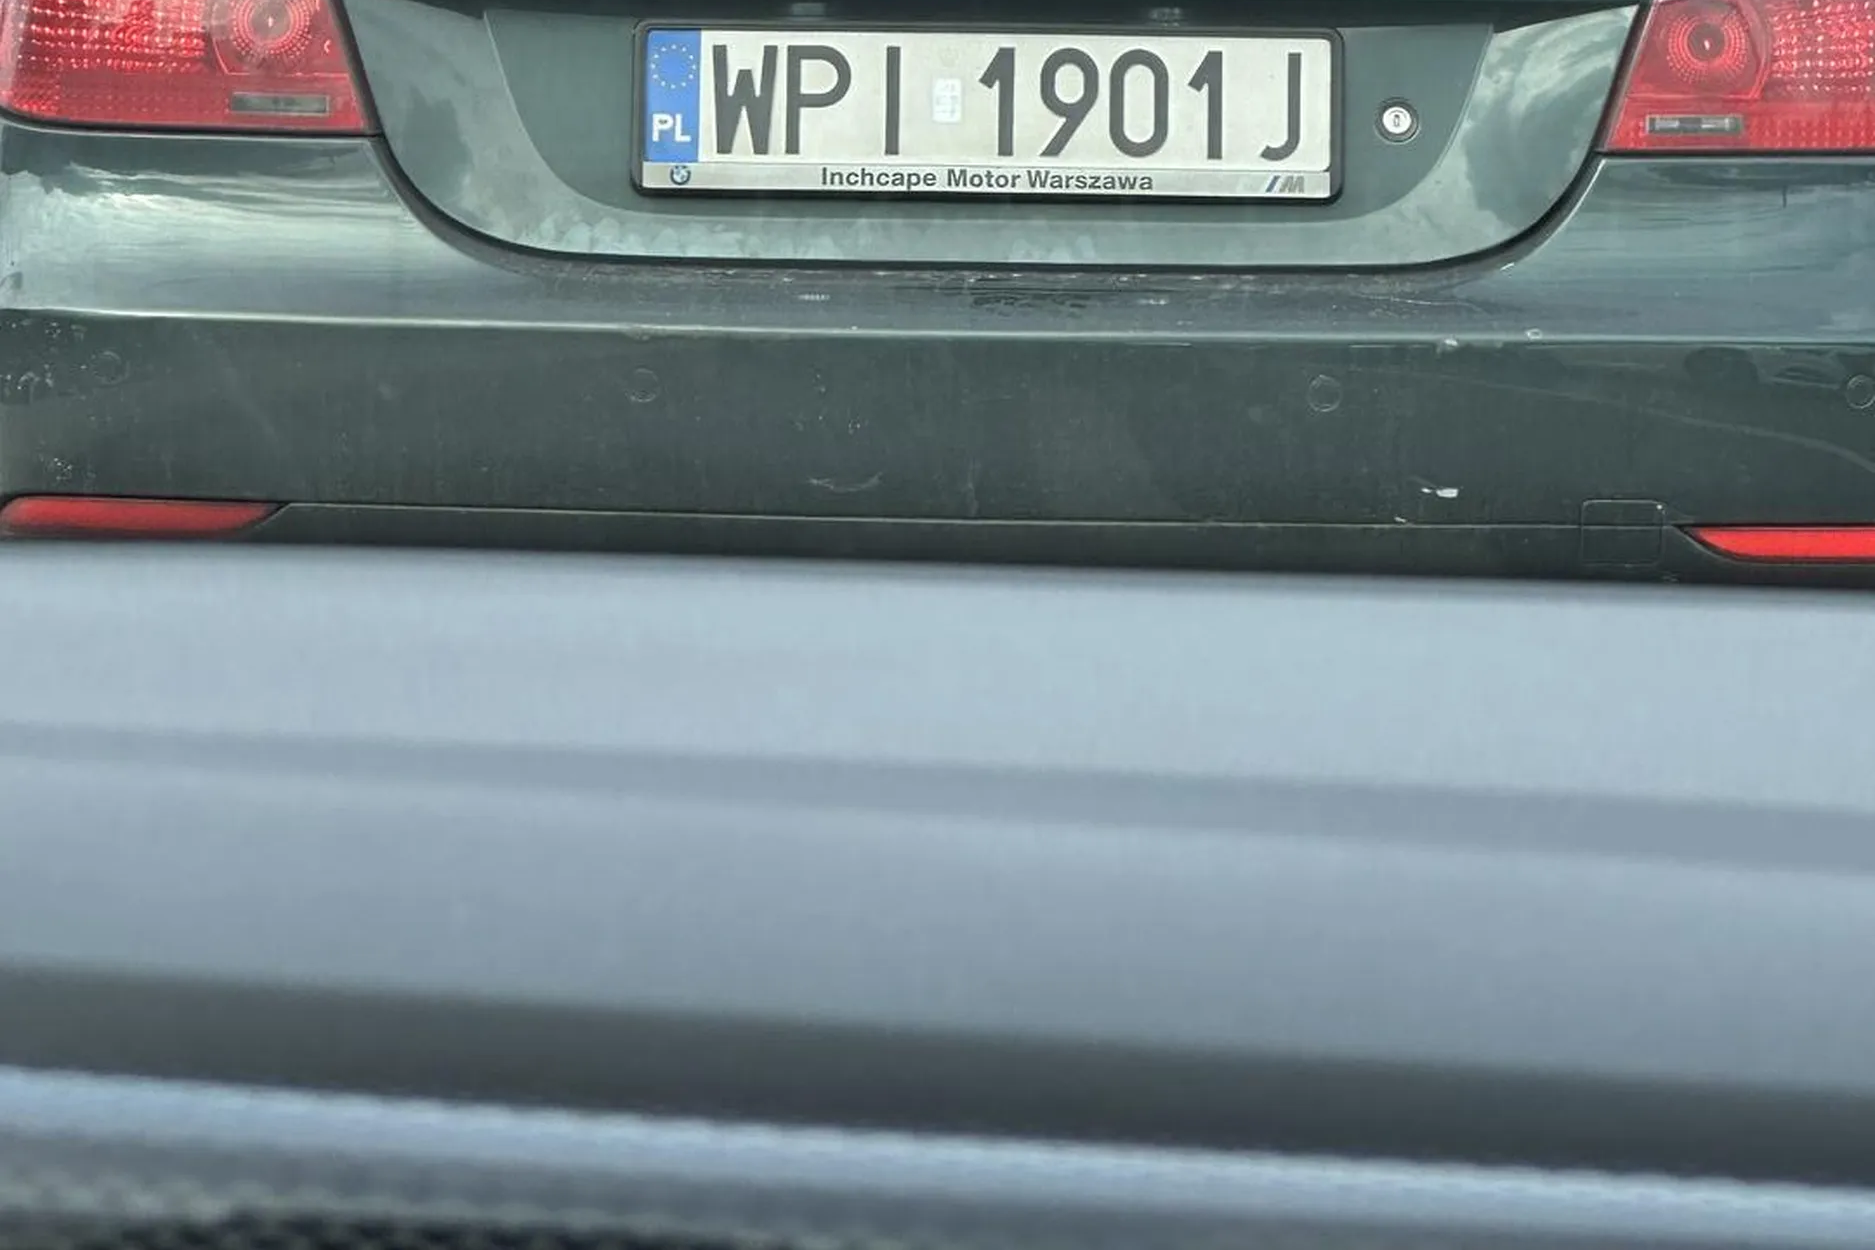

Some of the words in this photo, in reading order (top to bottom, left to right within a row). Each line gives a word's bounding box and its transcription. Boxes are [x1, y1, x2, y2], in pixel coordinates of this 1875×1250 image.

[712, 44, 901, 156] WPI
[978, 46, 1302, 161] 1901J
[652, 113, 691, 142] PL
[821, 167, 937, 190] Inchcape
[947, 168, 1021, 188] Motor
[1026, 169, 1153, 190] Warszawa
